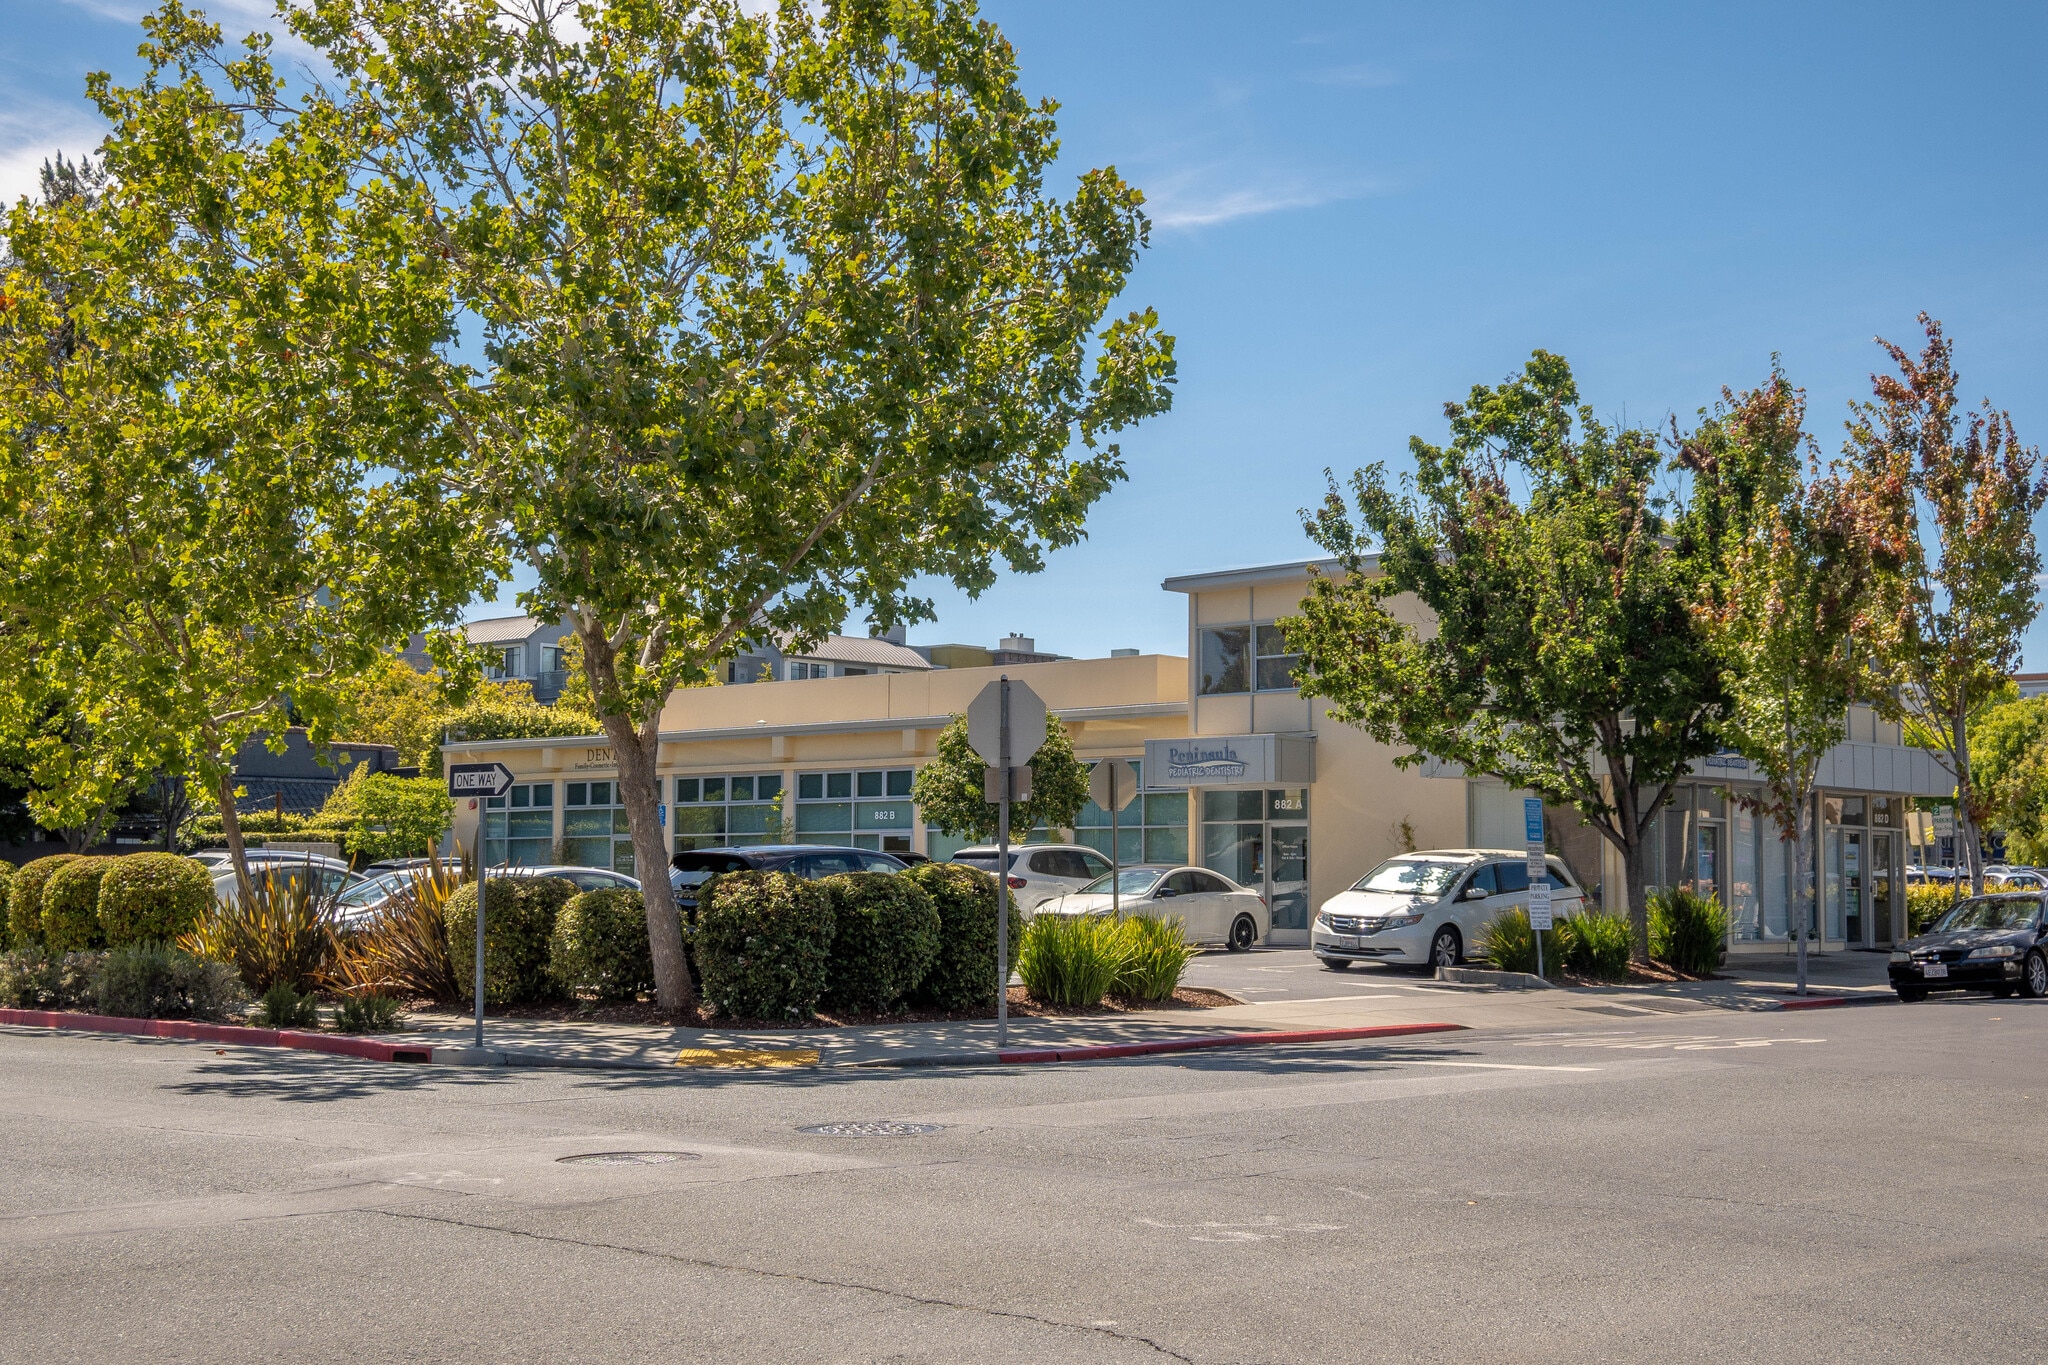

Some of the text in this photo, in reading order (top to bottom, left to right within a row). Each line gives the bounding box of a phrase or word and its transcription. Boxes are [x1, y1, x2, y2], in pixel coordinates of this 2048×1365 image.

[1168, 746, 1238, 762] Peninsula
[1168, 765, 1246, 778] PEDIATRIC DENTISTRY
[456, 773, 497, 787] ONE WAY
[1274, 799, 1303, 809] 882 A
[874, 810, 895, 820] 882 B
[1874, 814, 1890, 824] 882 D
